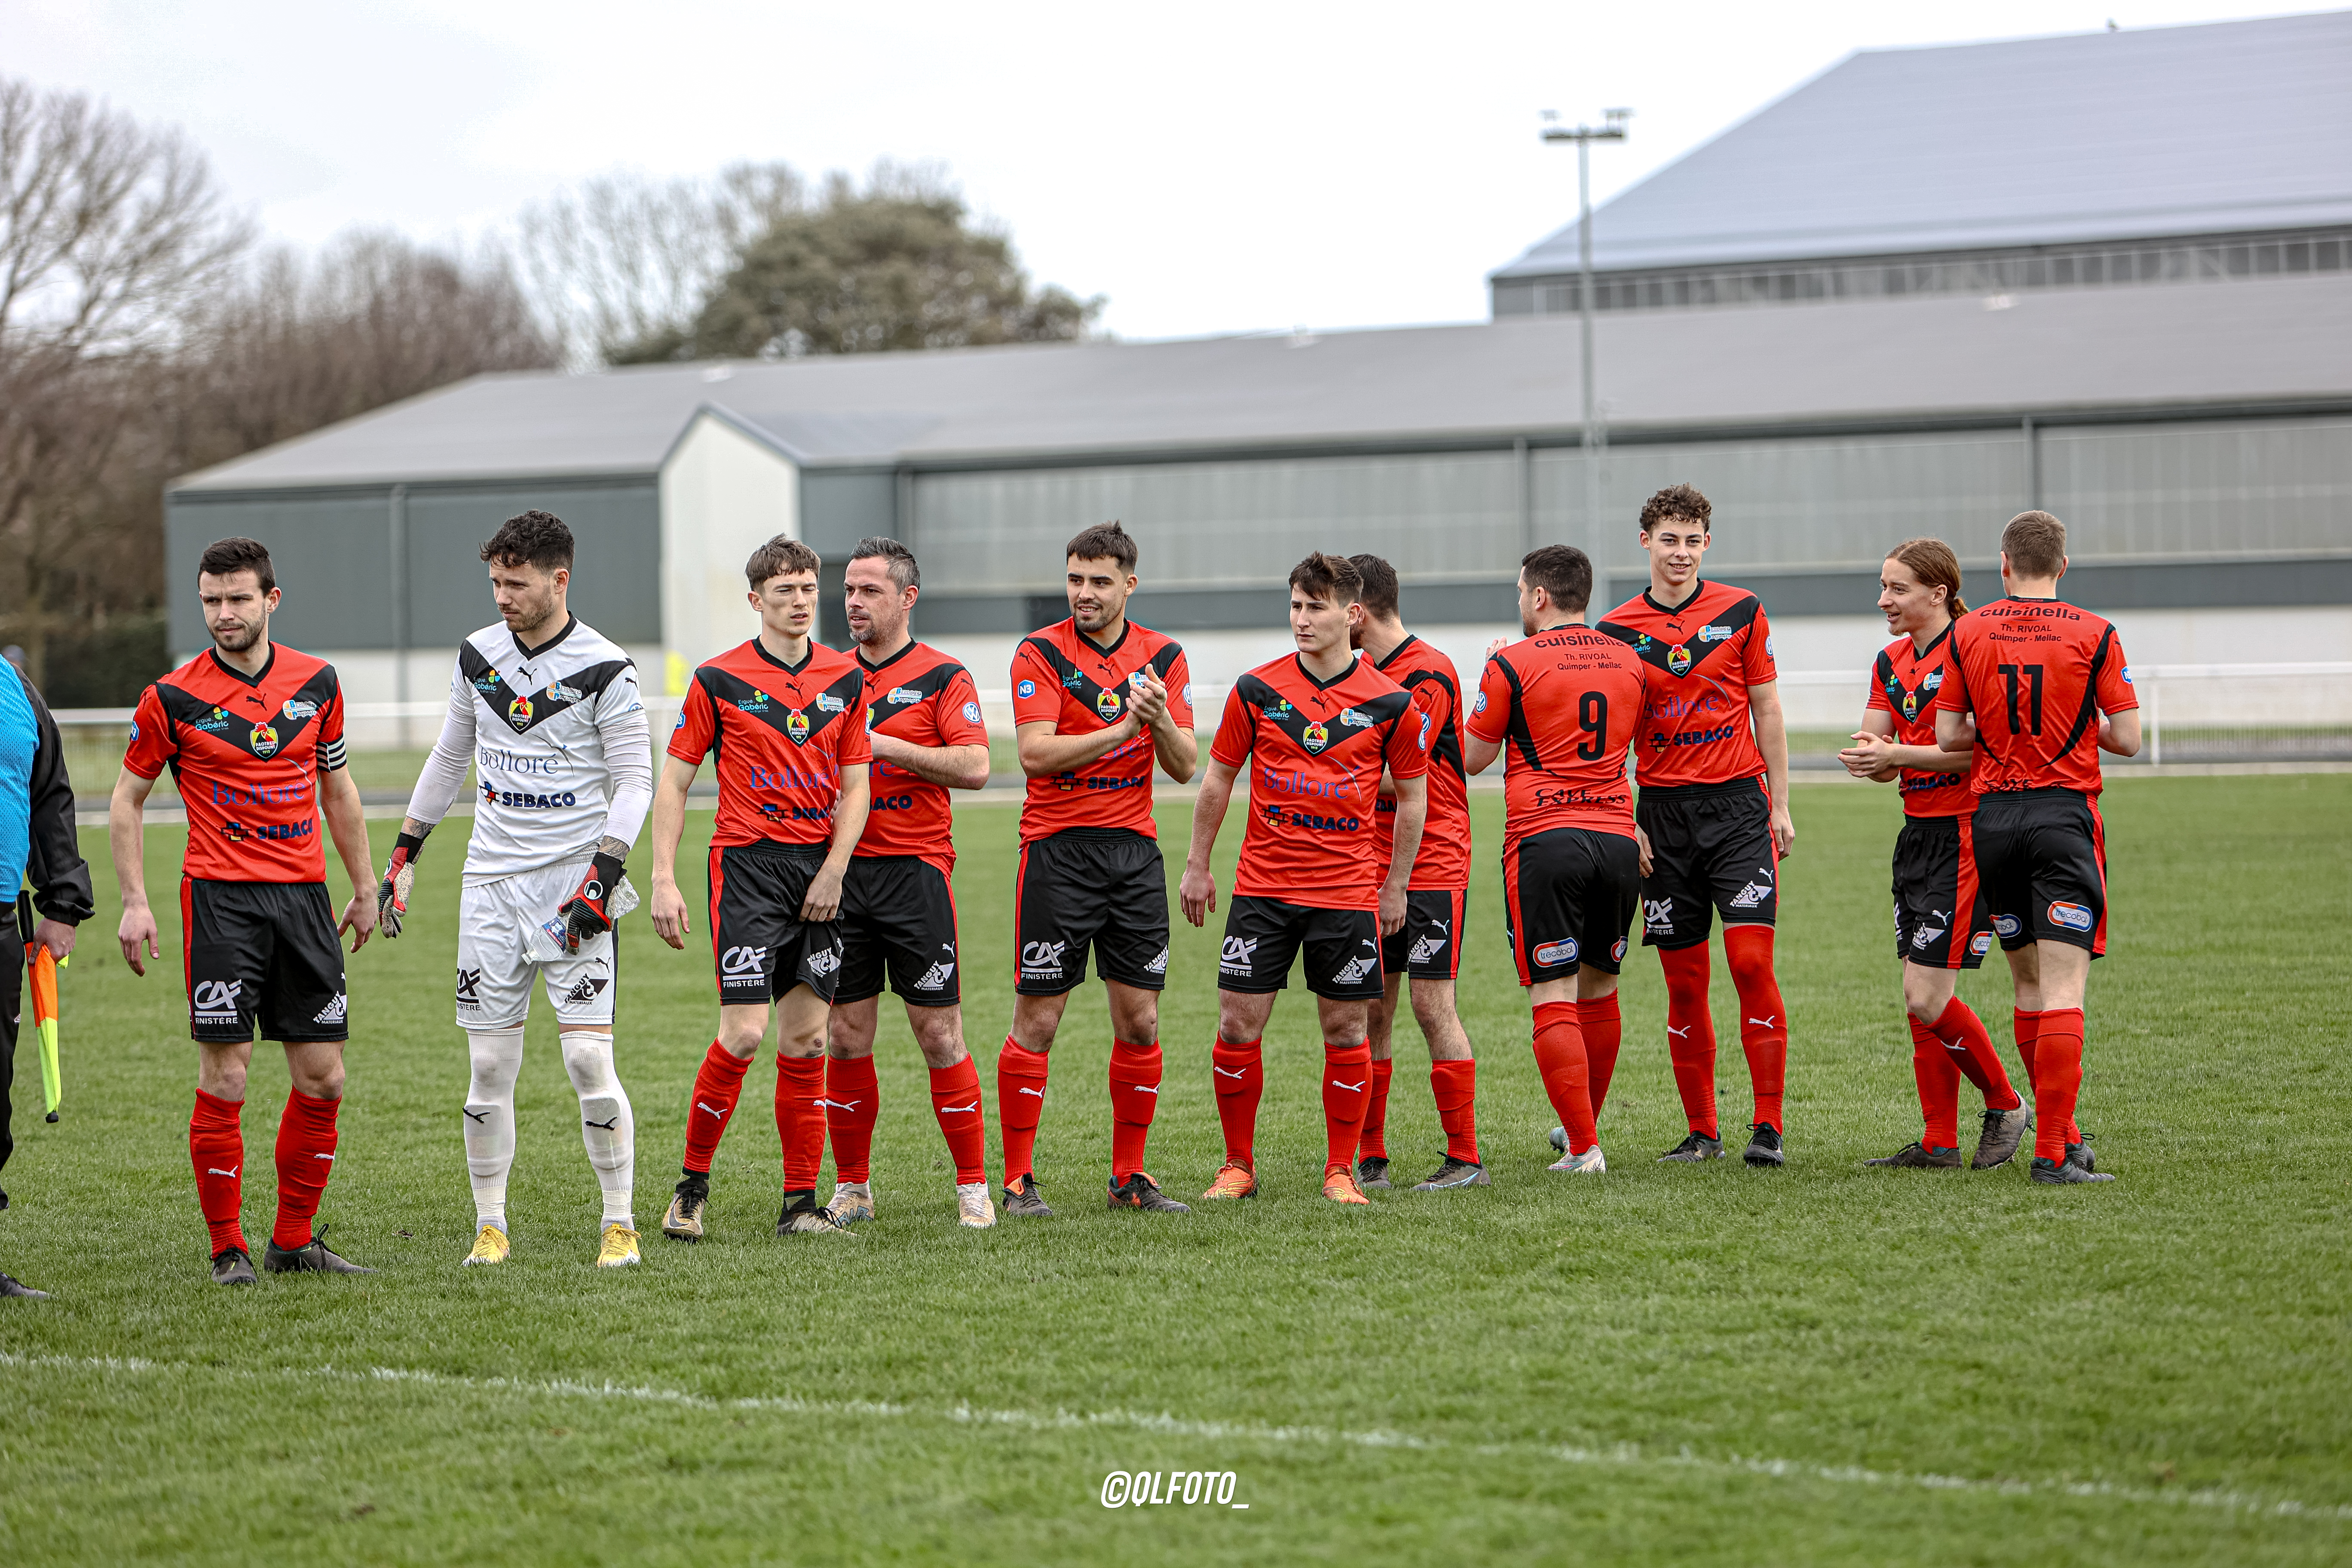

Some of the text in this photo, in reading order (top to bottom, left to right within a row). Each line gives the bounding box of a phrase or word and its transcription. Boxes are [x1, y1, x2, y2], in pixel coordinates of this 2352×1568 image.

[1980, 606, 2080, 621] cuisinella
[2000, 623, 2052, 633] Th. RIVOAL
[1534, 632, 1626, 648] cuisinella
[1989, 632, 2027, 643] Quimper
[2034, 634, 2062, 642] Mellac
[473, 683, 497, 691] Gabéric
[1020, 684, 1032, 695] N3
[738, 702, 769, 711] Gabéric
[1998, 664, 2043, 736] 11
[195, 720, 229, 731] Gabéric
[1577, 691, 1608, 761] 9
[1674, 725, 1734, 746] SEBACO
[480, 747, 558, 774] Bolloré
[749, 765, 830, 788] Bolloré
[1264, 767, 1348, 799] Bolloré
[211, 779, 306, 805] Bolloré
[502, 791, 576, 808] SEBACO
[1535, 788, 1592, 797] CAVE
[1536, 794, 1627, 807] EXPRESS
[1292, 813, 1359, 831] SEBACO
[1730, 880, 1755, 907] TANGUY
[2055, 909, 2088, 923] trecobat
[1143, 944, 1168, 971] TANGUY
[1540, 945, 1574, 959] trecobat
[913, 960, 940, 989] TANGUY
[1332, 955, 1358, 984] TANGUY
[564, 973, 590, 1004] TANGUY
[723, 979, 765, 988] FINISTÈRE
[313, 990, 341, 1024] TANGUY
